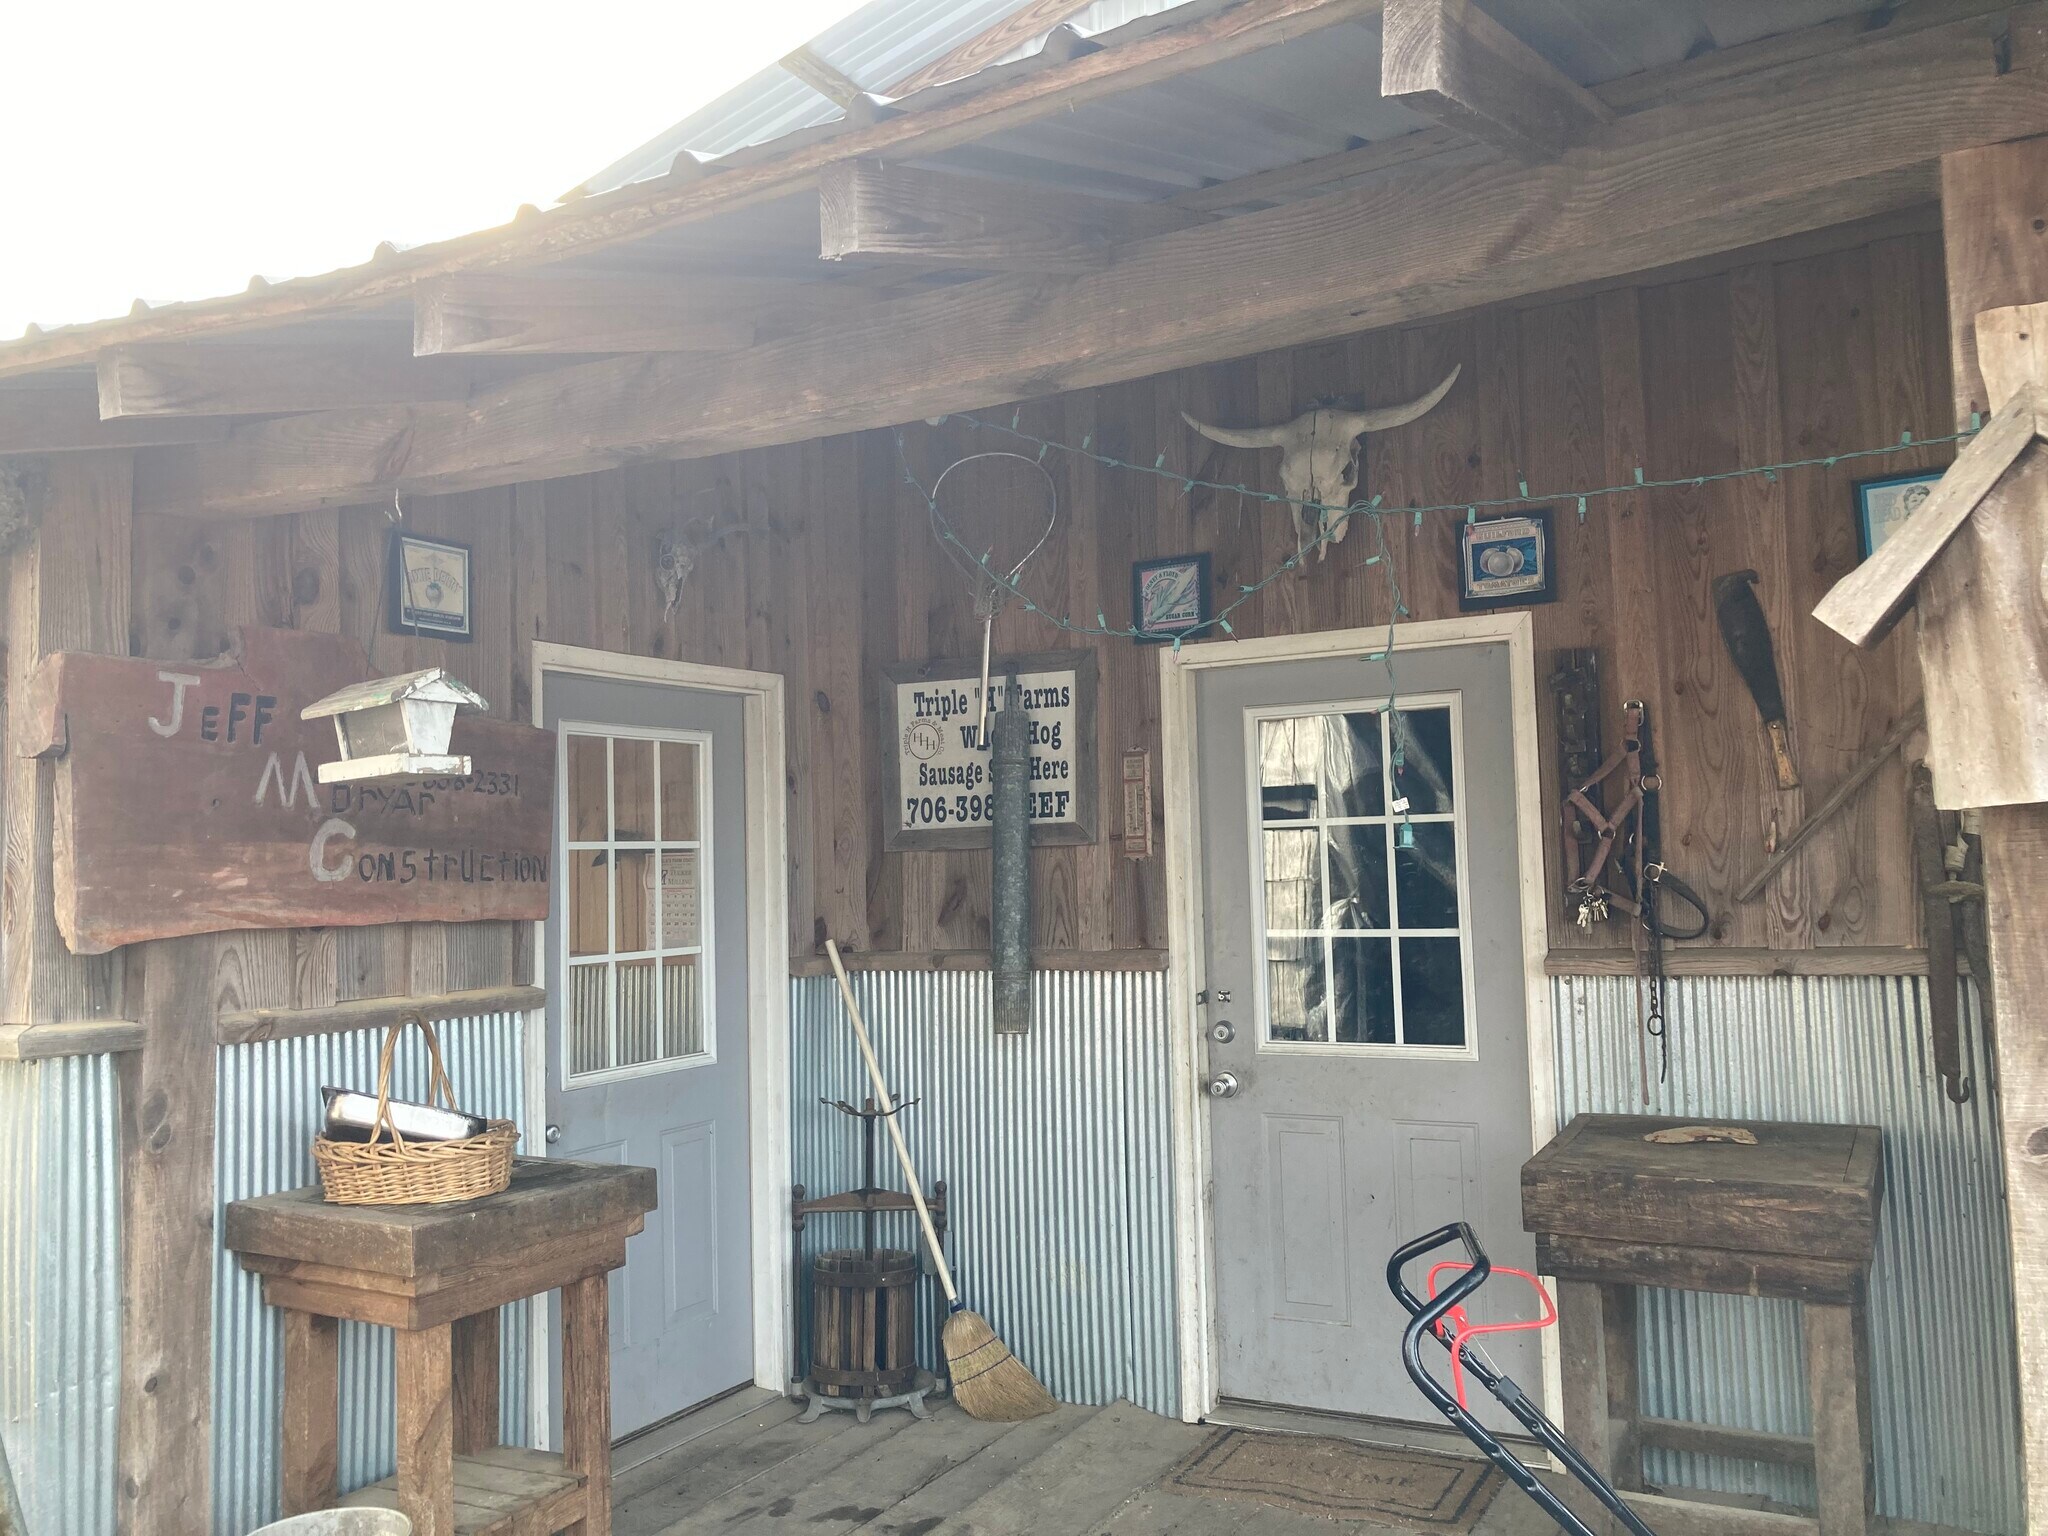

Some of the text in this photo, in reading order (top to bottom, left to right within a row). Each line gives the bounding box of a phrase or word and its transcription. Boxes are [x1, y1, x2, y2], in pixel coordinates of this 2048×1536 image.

[913, 688, 968, 721] Triple
[1028, 721, 1062, 750] Hog
[919, 762, 983, 790] Sausage
[1029, 756, 1069, 780] Here
